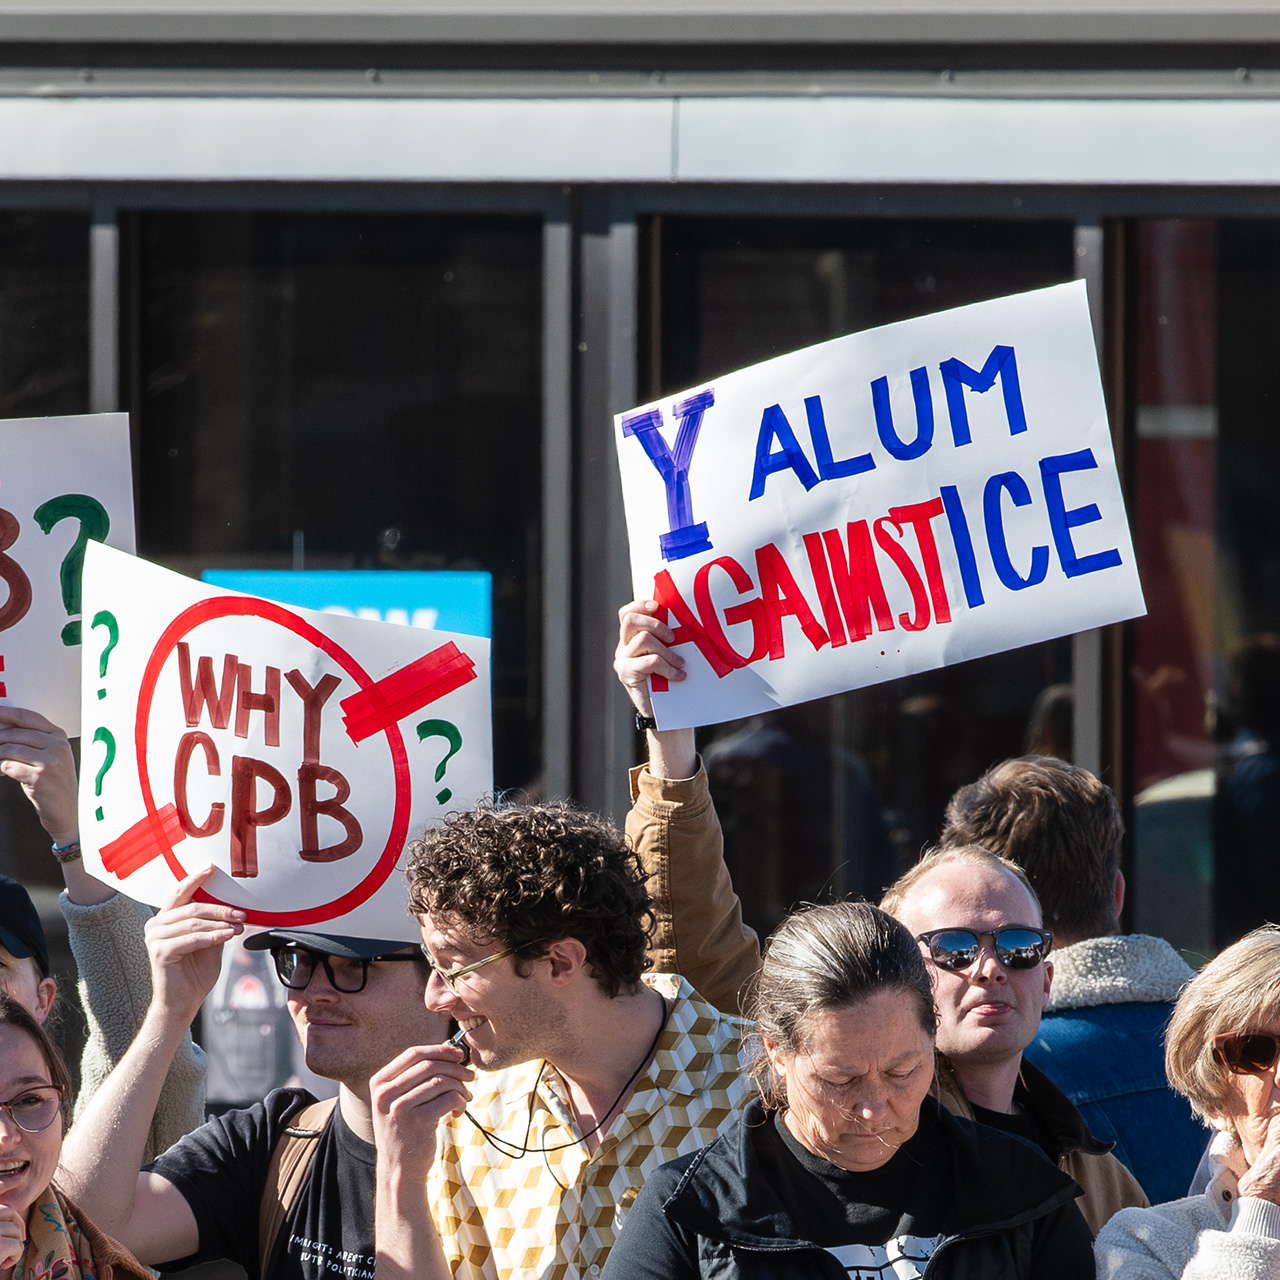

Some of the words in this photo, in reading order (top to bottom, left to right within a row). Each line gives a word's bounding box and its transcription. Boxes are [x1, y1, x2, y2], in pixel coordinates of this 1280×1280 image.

[621, 388, 716, 562] Y
[749, 345, 1029, 502] ALUM
[651, 496, 952, 693] AGAINST
[940, 447, 1123, 610] ICE
[176, 642, 343, 765] WHY
[173, 731, 364, 878] CPB
[326, 1259, 375, 1280] POLITICIAN
